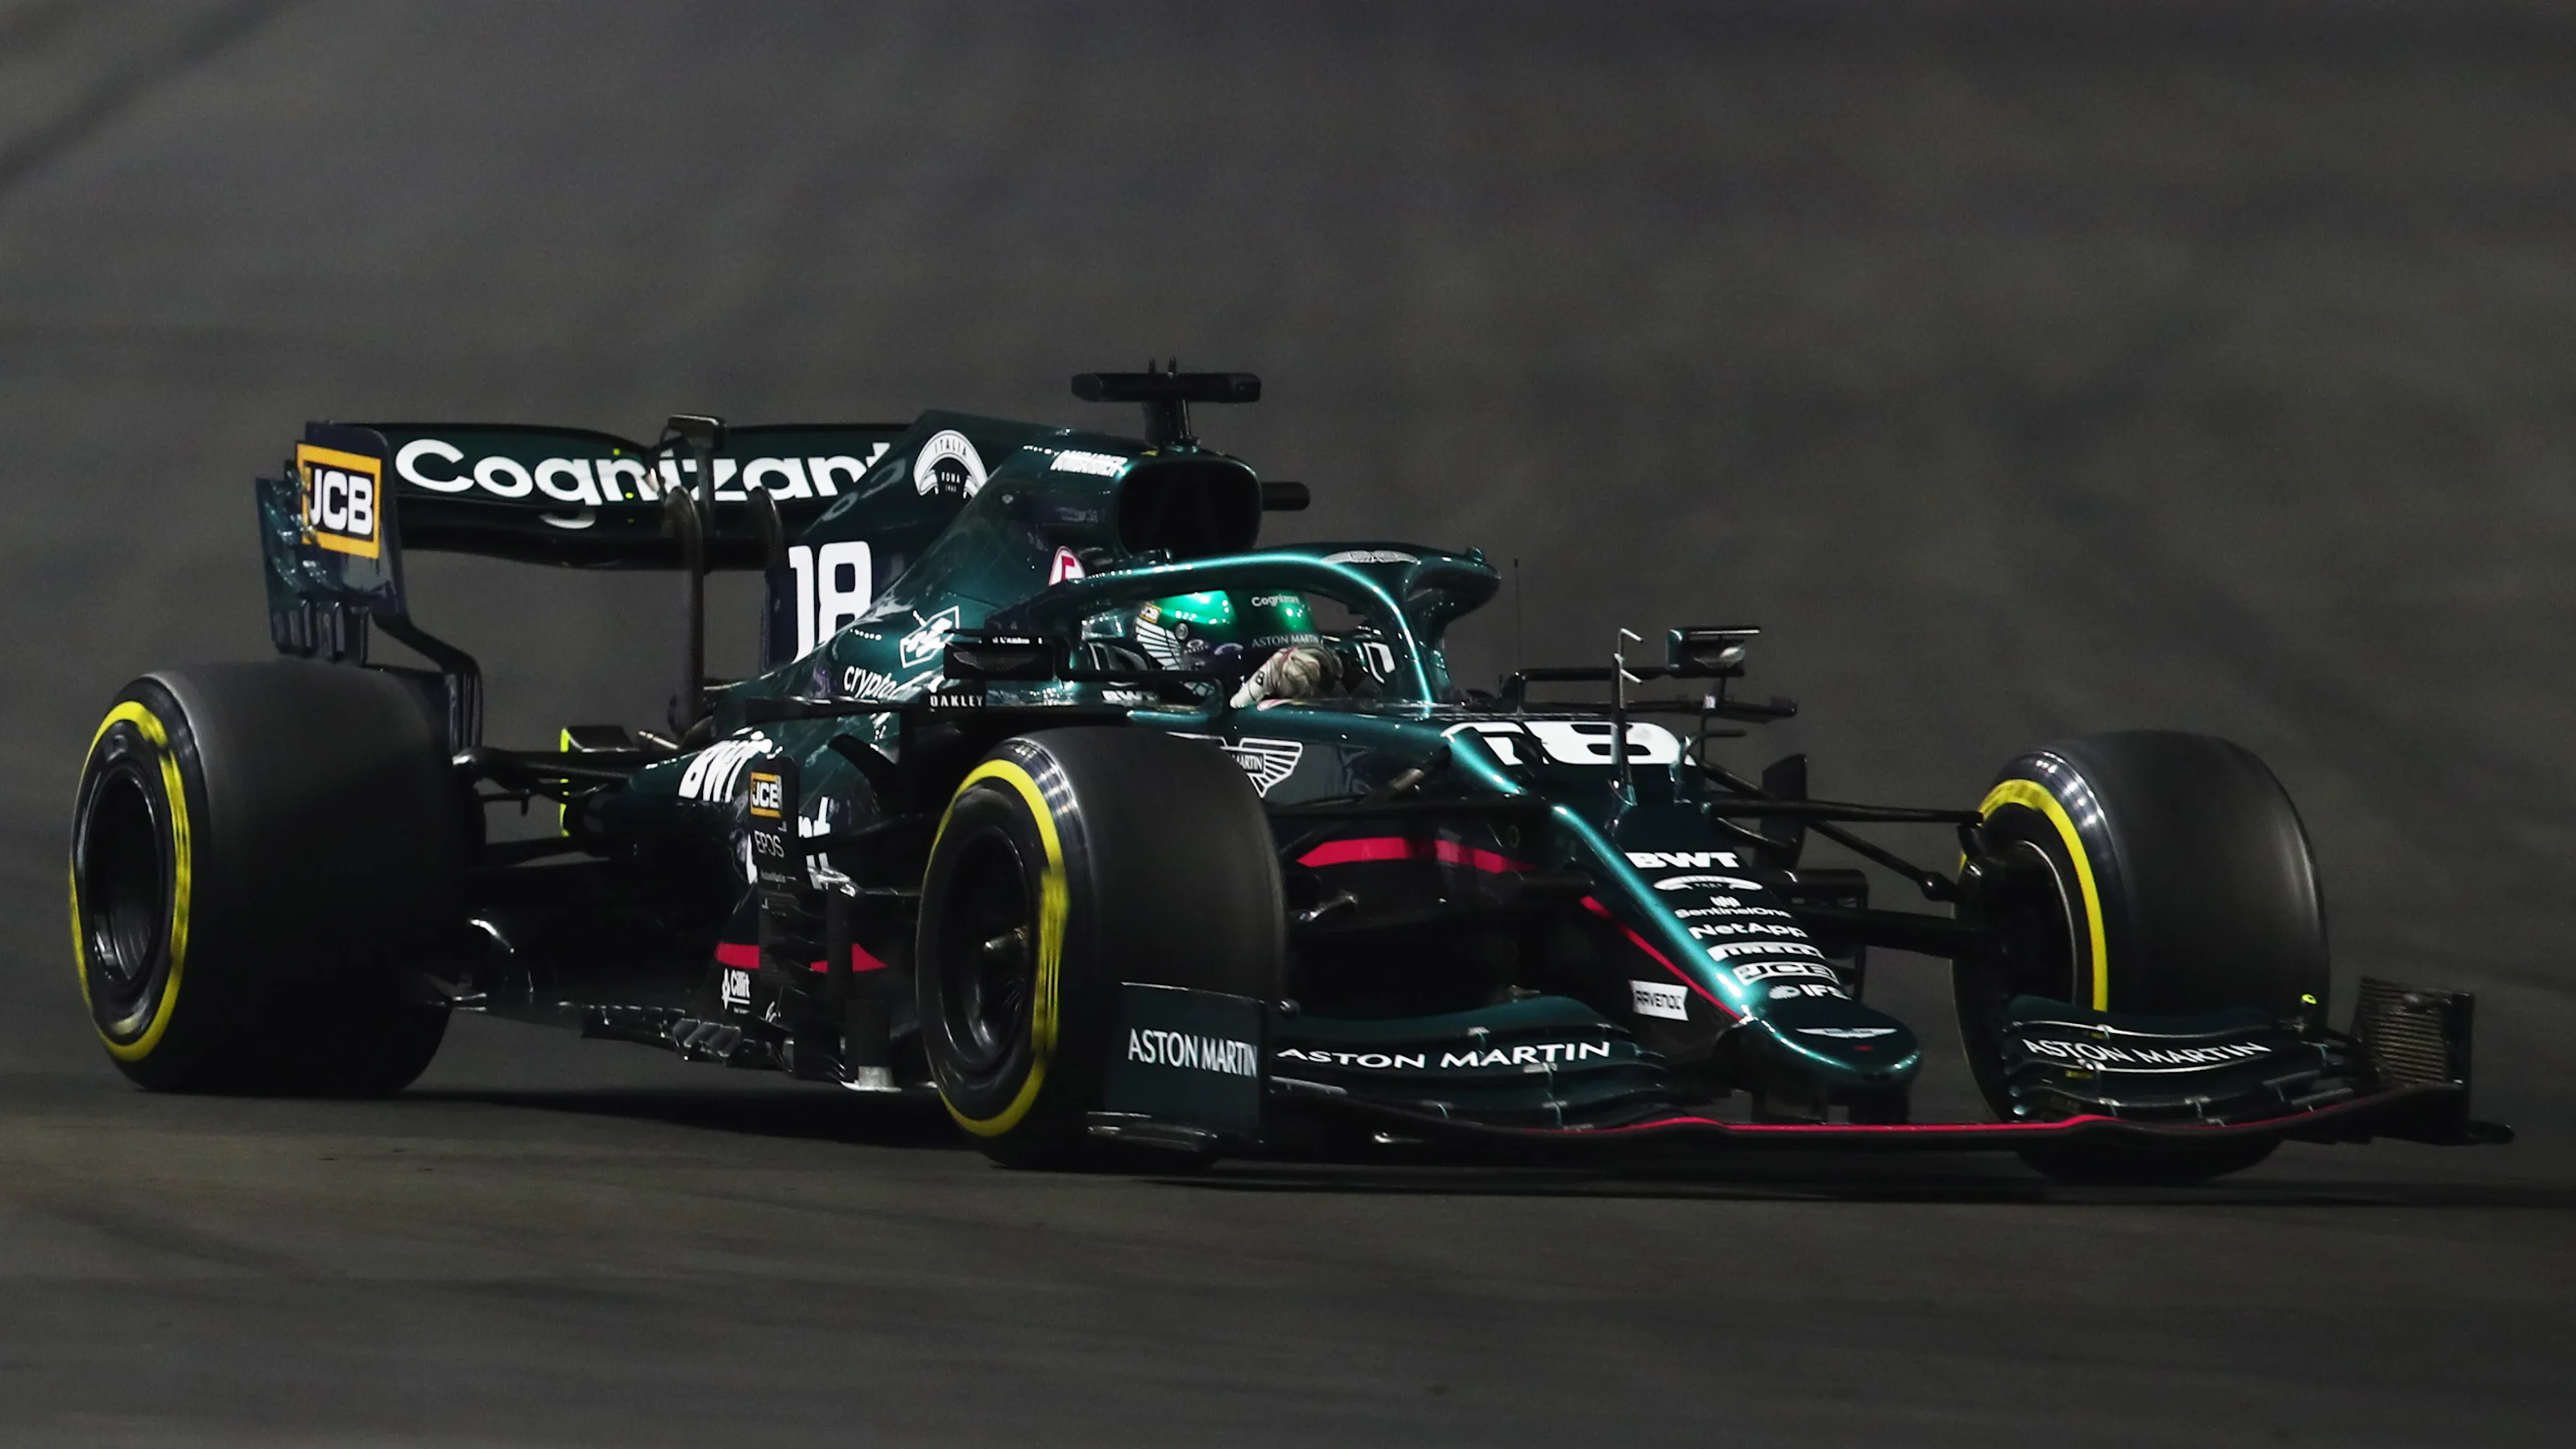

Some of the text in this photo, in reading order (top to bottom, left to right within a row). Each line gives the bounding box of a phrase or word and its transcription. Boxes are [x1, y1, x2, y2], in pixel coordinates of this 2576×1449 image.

[935, 438, 966, 458] ITALIA
[308, 468, 374, 535] JCB
[788, 539, 873, 665] 18
[1251, 634, 1319, 648] ASTON MARTIN
[929, 694, 983, 707] OAKLEY
[1624, 852, 1740, 869] BWT
[1674, 906, 1792, 919] SentinelOne
[1688, 923, 1809, 940] NetApp
[1635, 989, 1682, 1010] RAVENOL
[1127, 1027, 1258, 1079] ASTON MARTIN
[1276, 1041, 1611, 1069] ASTON MARTIN
[2022, 1038, 2272, 1063] ASTON MARTIN
